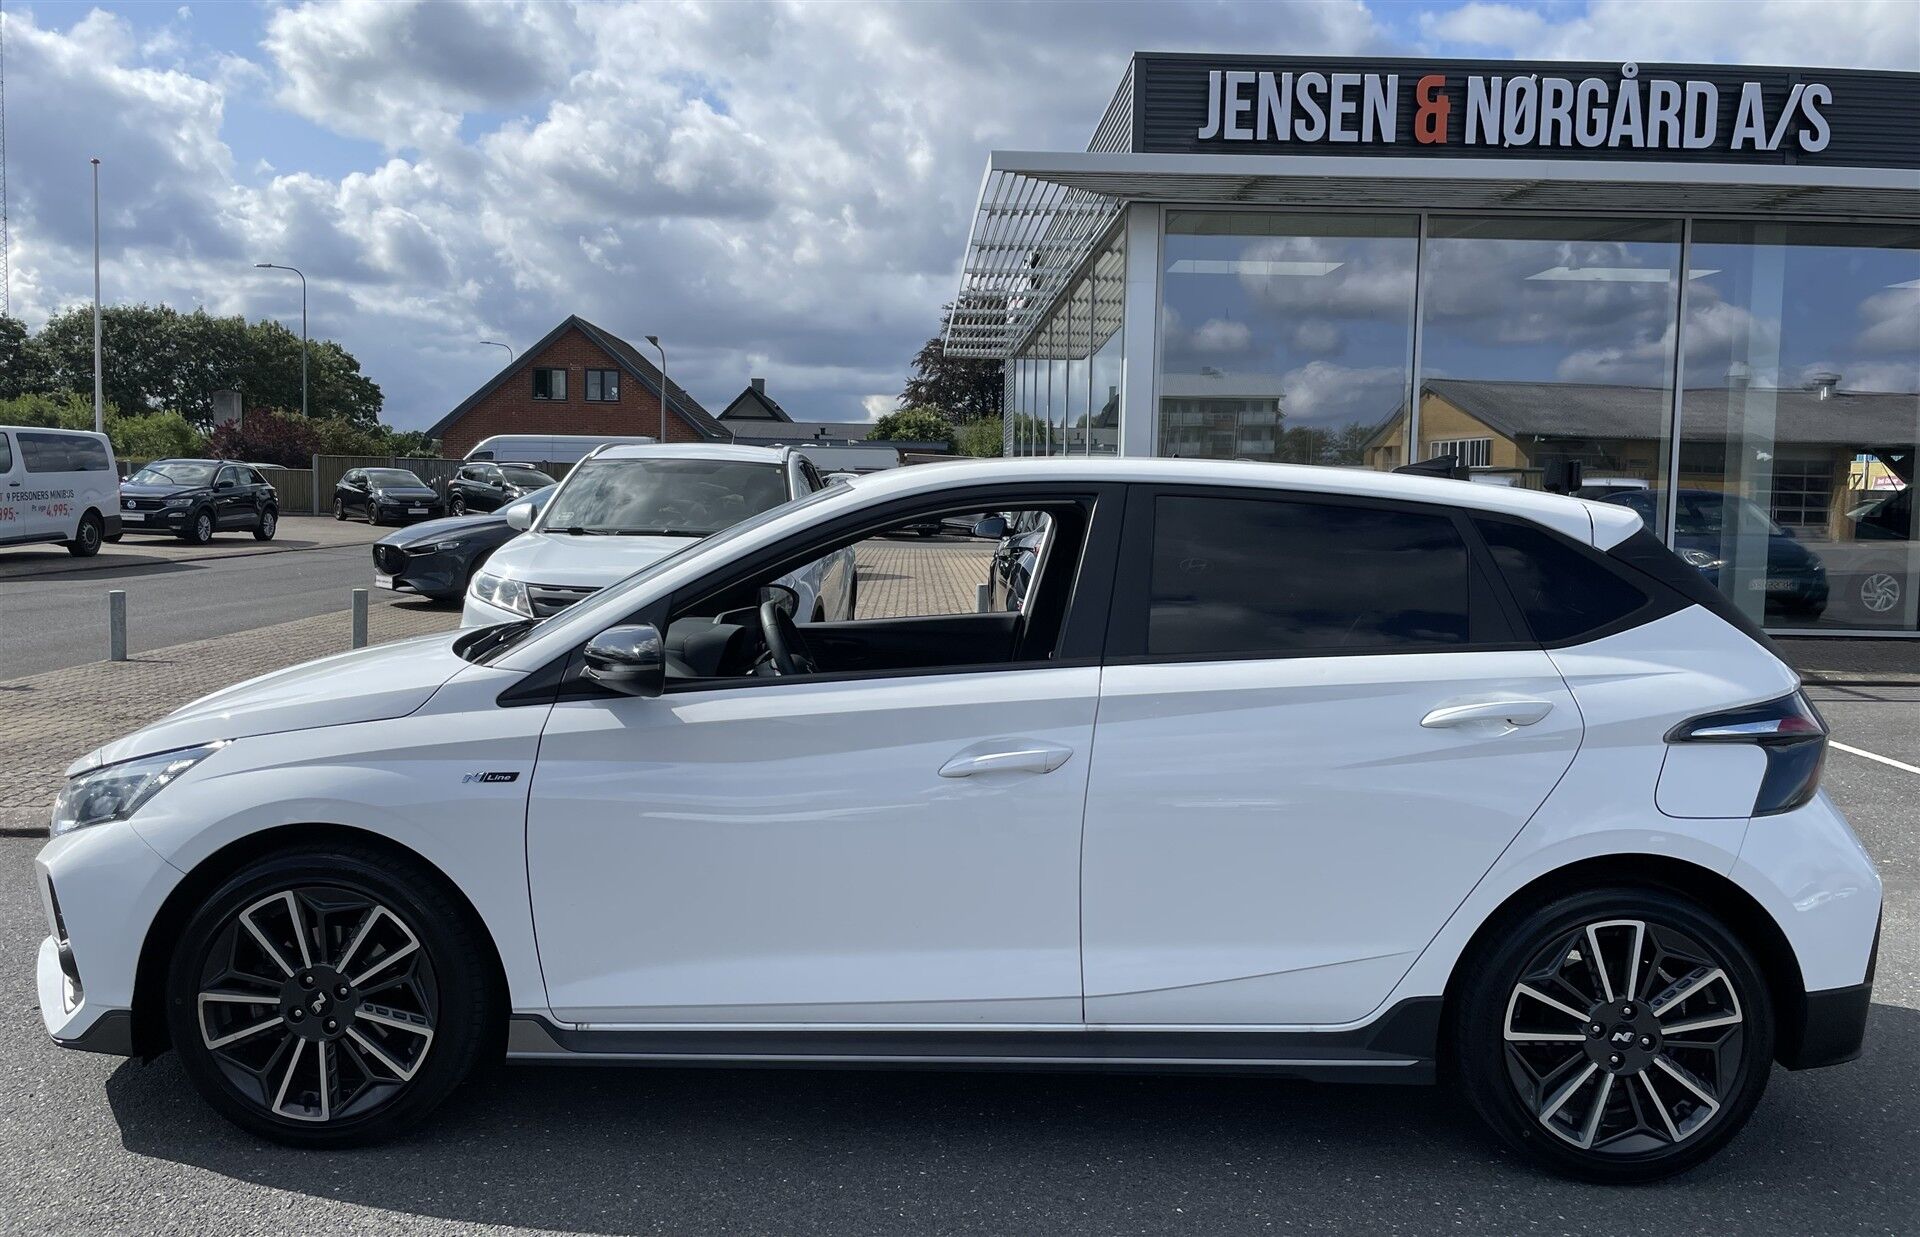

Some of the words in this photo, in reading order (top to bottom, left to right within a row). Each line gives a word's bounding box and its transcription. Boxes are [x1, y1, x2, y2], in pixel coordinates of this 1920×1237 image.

[1198, 70, 1399, 144] JENSEN
[1414, 74, 1451, 145] &
[1464, 61, 1719, 151] NØRGÅRD
[1730, 82, 1833, 153] A/S
[11, 490, 49, 502] PERSONERS
[50, 489, 75, 500] MINIBUS
